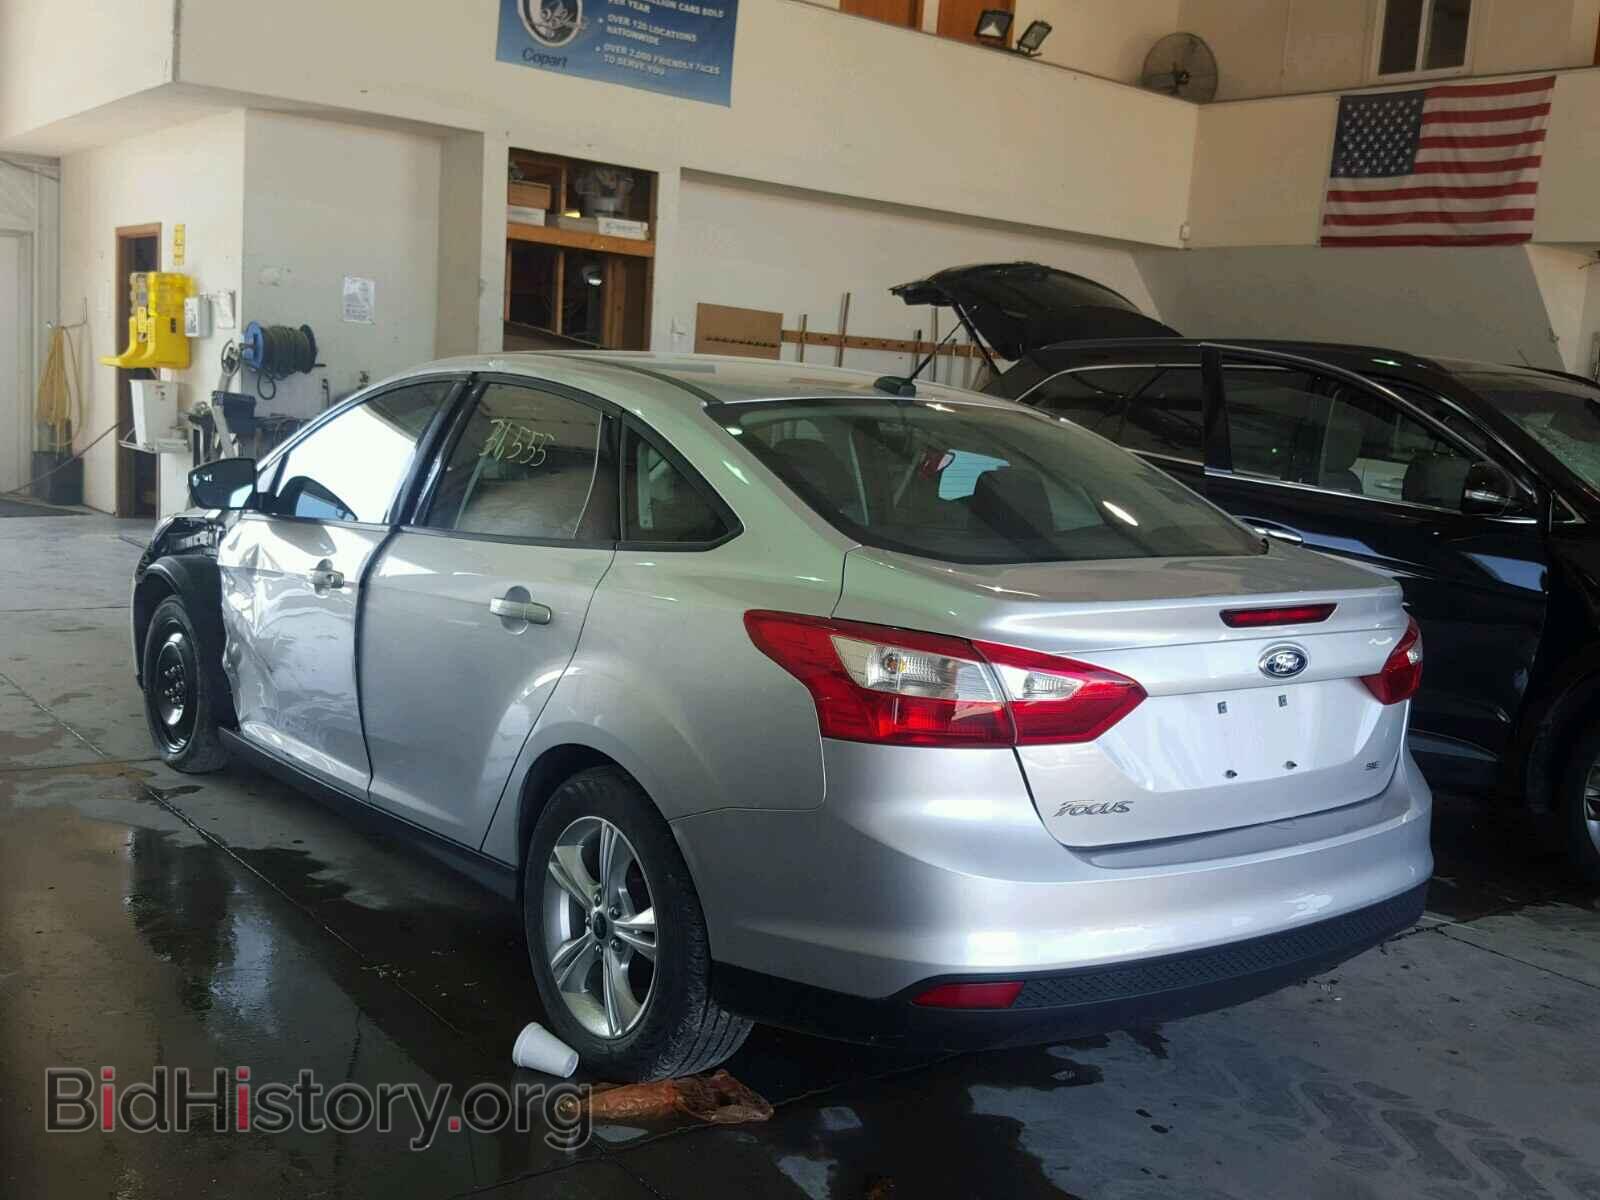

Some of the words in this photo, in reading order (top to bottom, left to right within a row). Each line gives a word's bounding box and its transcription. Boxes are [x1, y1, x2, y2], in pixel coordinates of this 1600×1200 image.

[628, 0, 650, 13] YEAR
[678, 3, 700, 14] CARS
[702, 8, 724, 18] SOLD
[607, 14, 631, 26] OVER
[649, 24, 697, 42] LOCATIONS
[607, 26, 659, 46] NATIONWIDE
[522, 47, 567, 67] Copart
[604, 43, 627, 55] OVER
[653, 54, 694, 69] FRIENDLY
[694, 63, 720, 75] FACES
[604, 54, 615, 64] TO
[616, 57, 645, 70] SERVE
[647, 64, 665, 76] YOU
